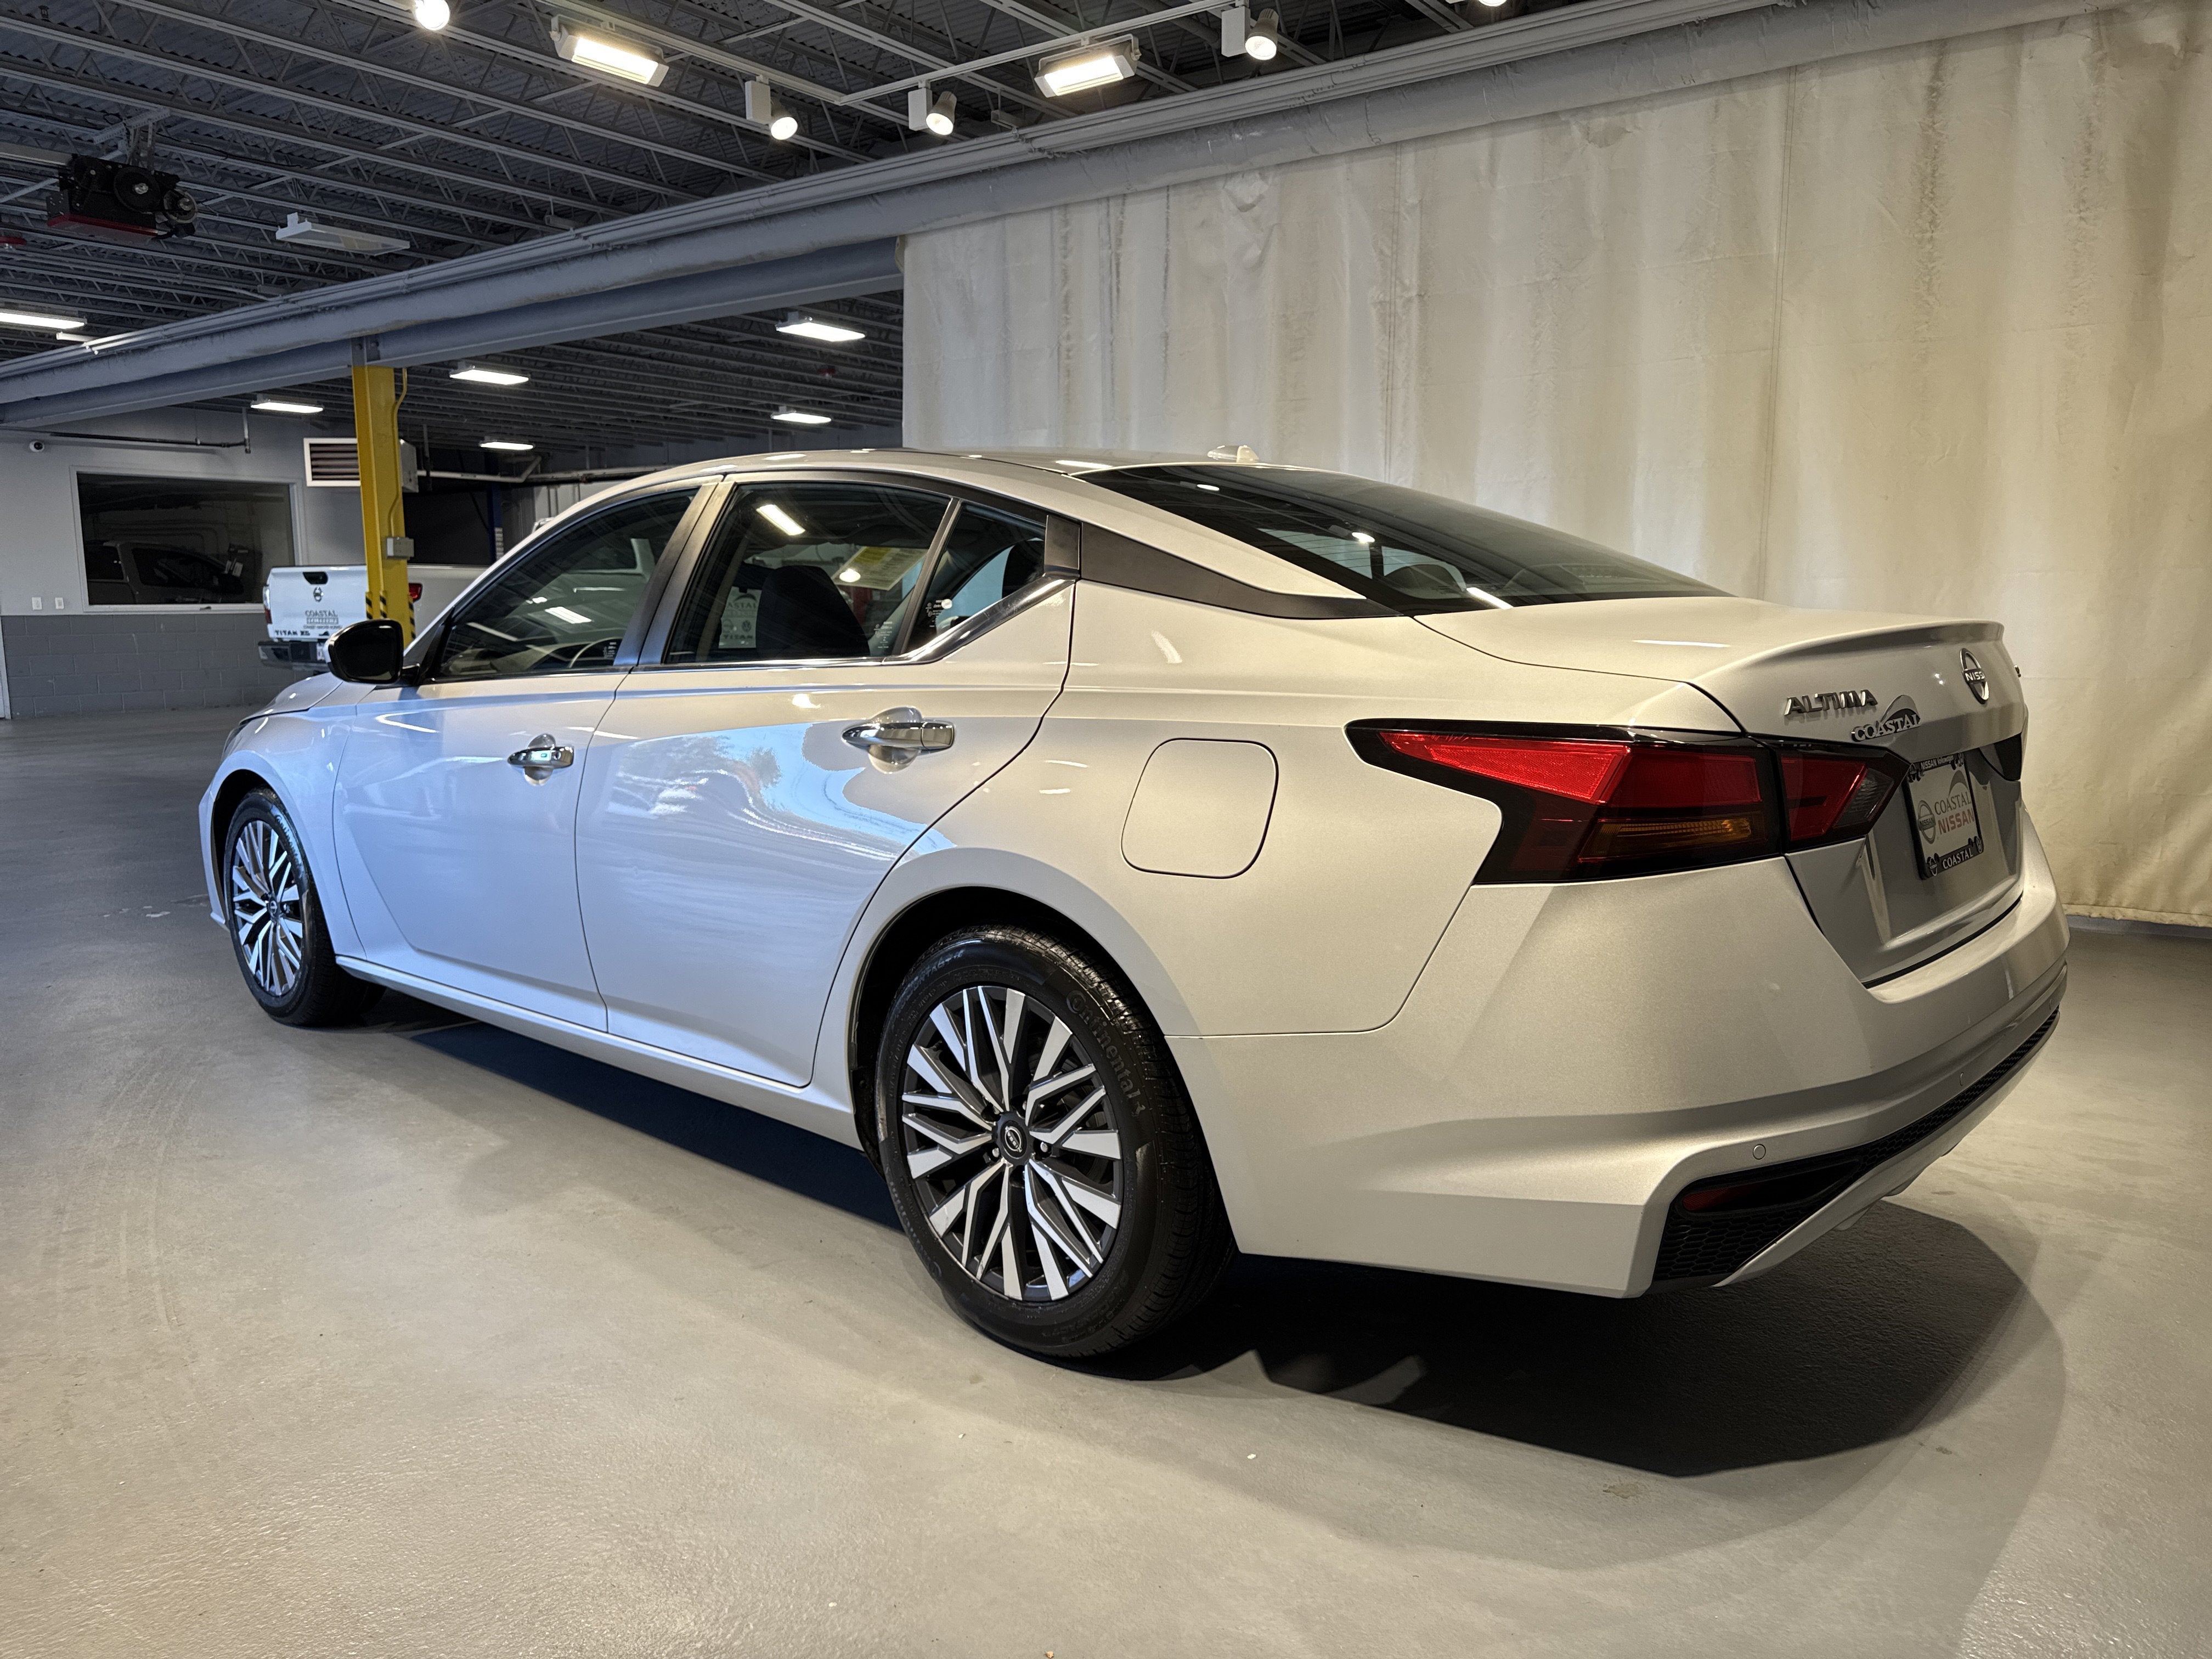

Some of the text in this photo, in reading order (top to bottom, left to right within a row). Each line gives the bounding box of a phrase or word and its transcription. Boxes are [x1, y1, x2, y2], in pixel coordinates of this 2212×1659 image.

[1783, 689, 1878, 715] ALTIMA
[1852, 714, 1921, 742] COASTAL
[1934, 792, 1972, 815] COASTAL
[1938, 808, 1975, 835] NISSAN
[1943, 848, 1974, 870] COASTAL
[1066, 990, 1141, 1099] Continental
